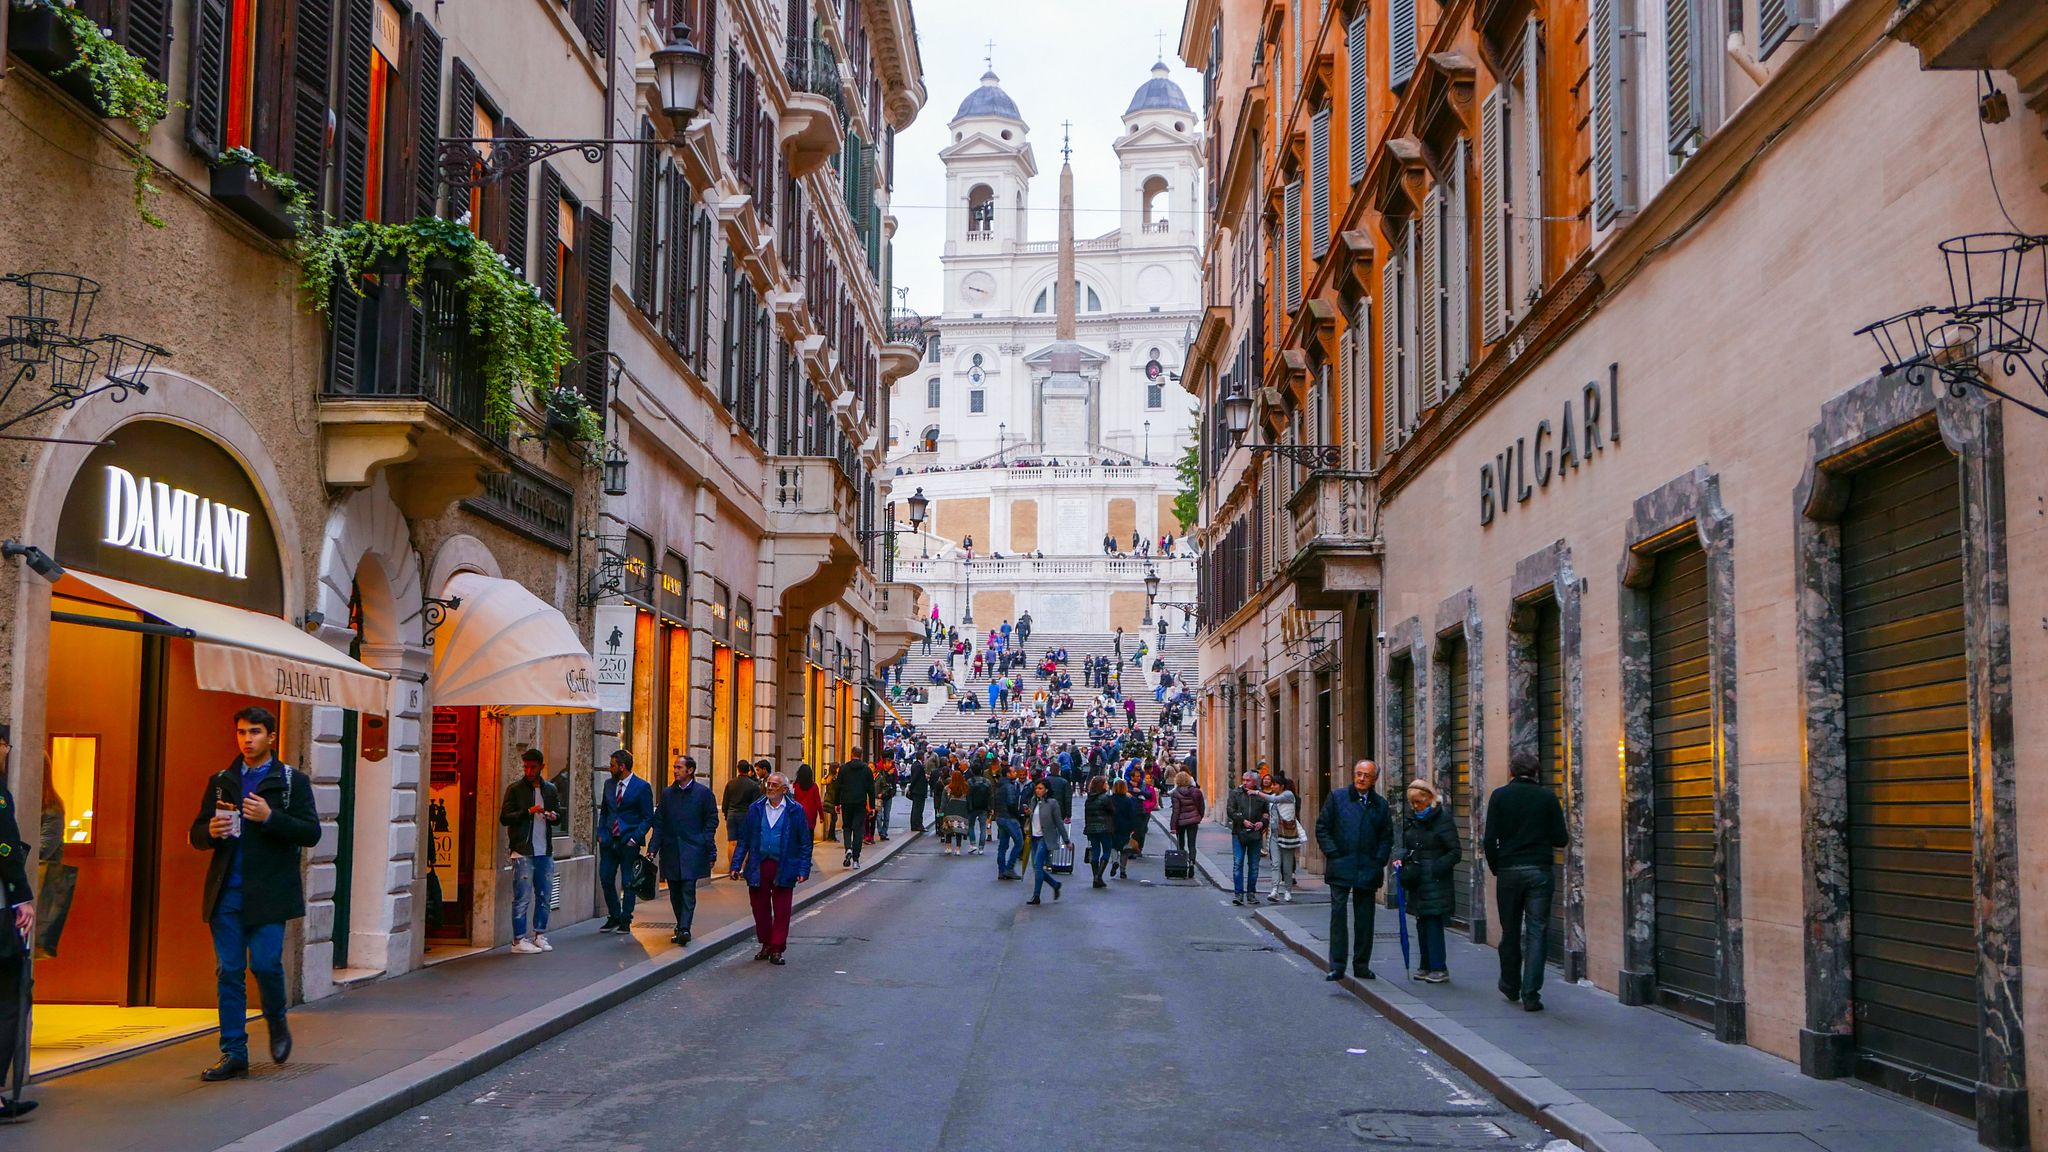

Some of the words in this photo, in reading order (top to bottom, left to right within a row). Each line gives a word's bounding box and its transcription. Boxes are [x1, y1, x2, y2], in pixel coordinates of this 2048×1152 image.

[1479, 361, 1621, 527] BVLGARI
[104, 465, 250, 579] DAMIANI
[598, 672, 626, 680] ANNI
[599, 658, 627, 672] 250
[275, 668, 332, 703] DAMIANI
